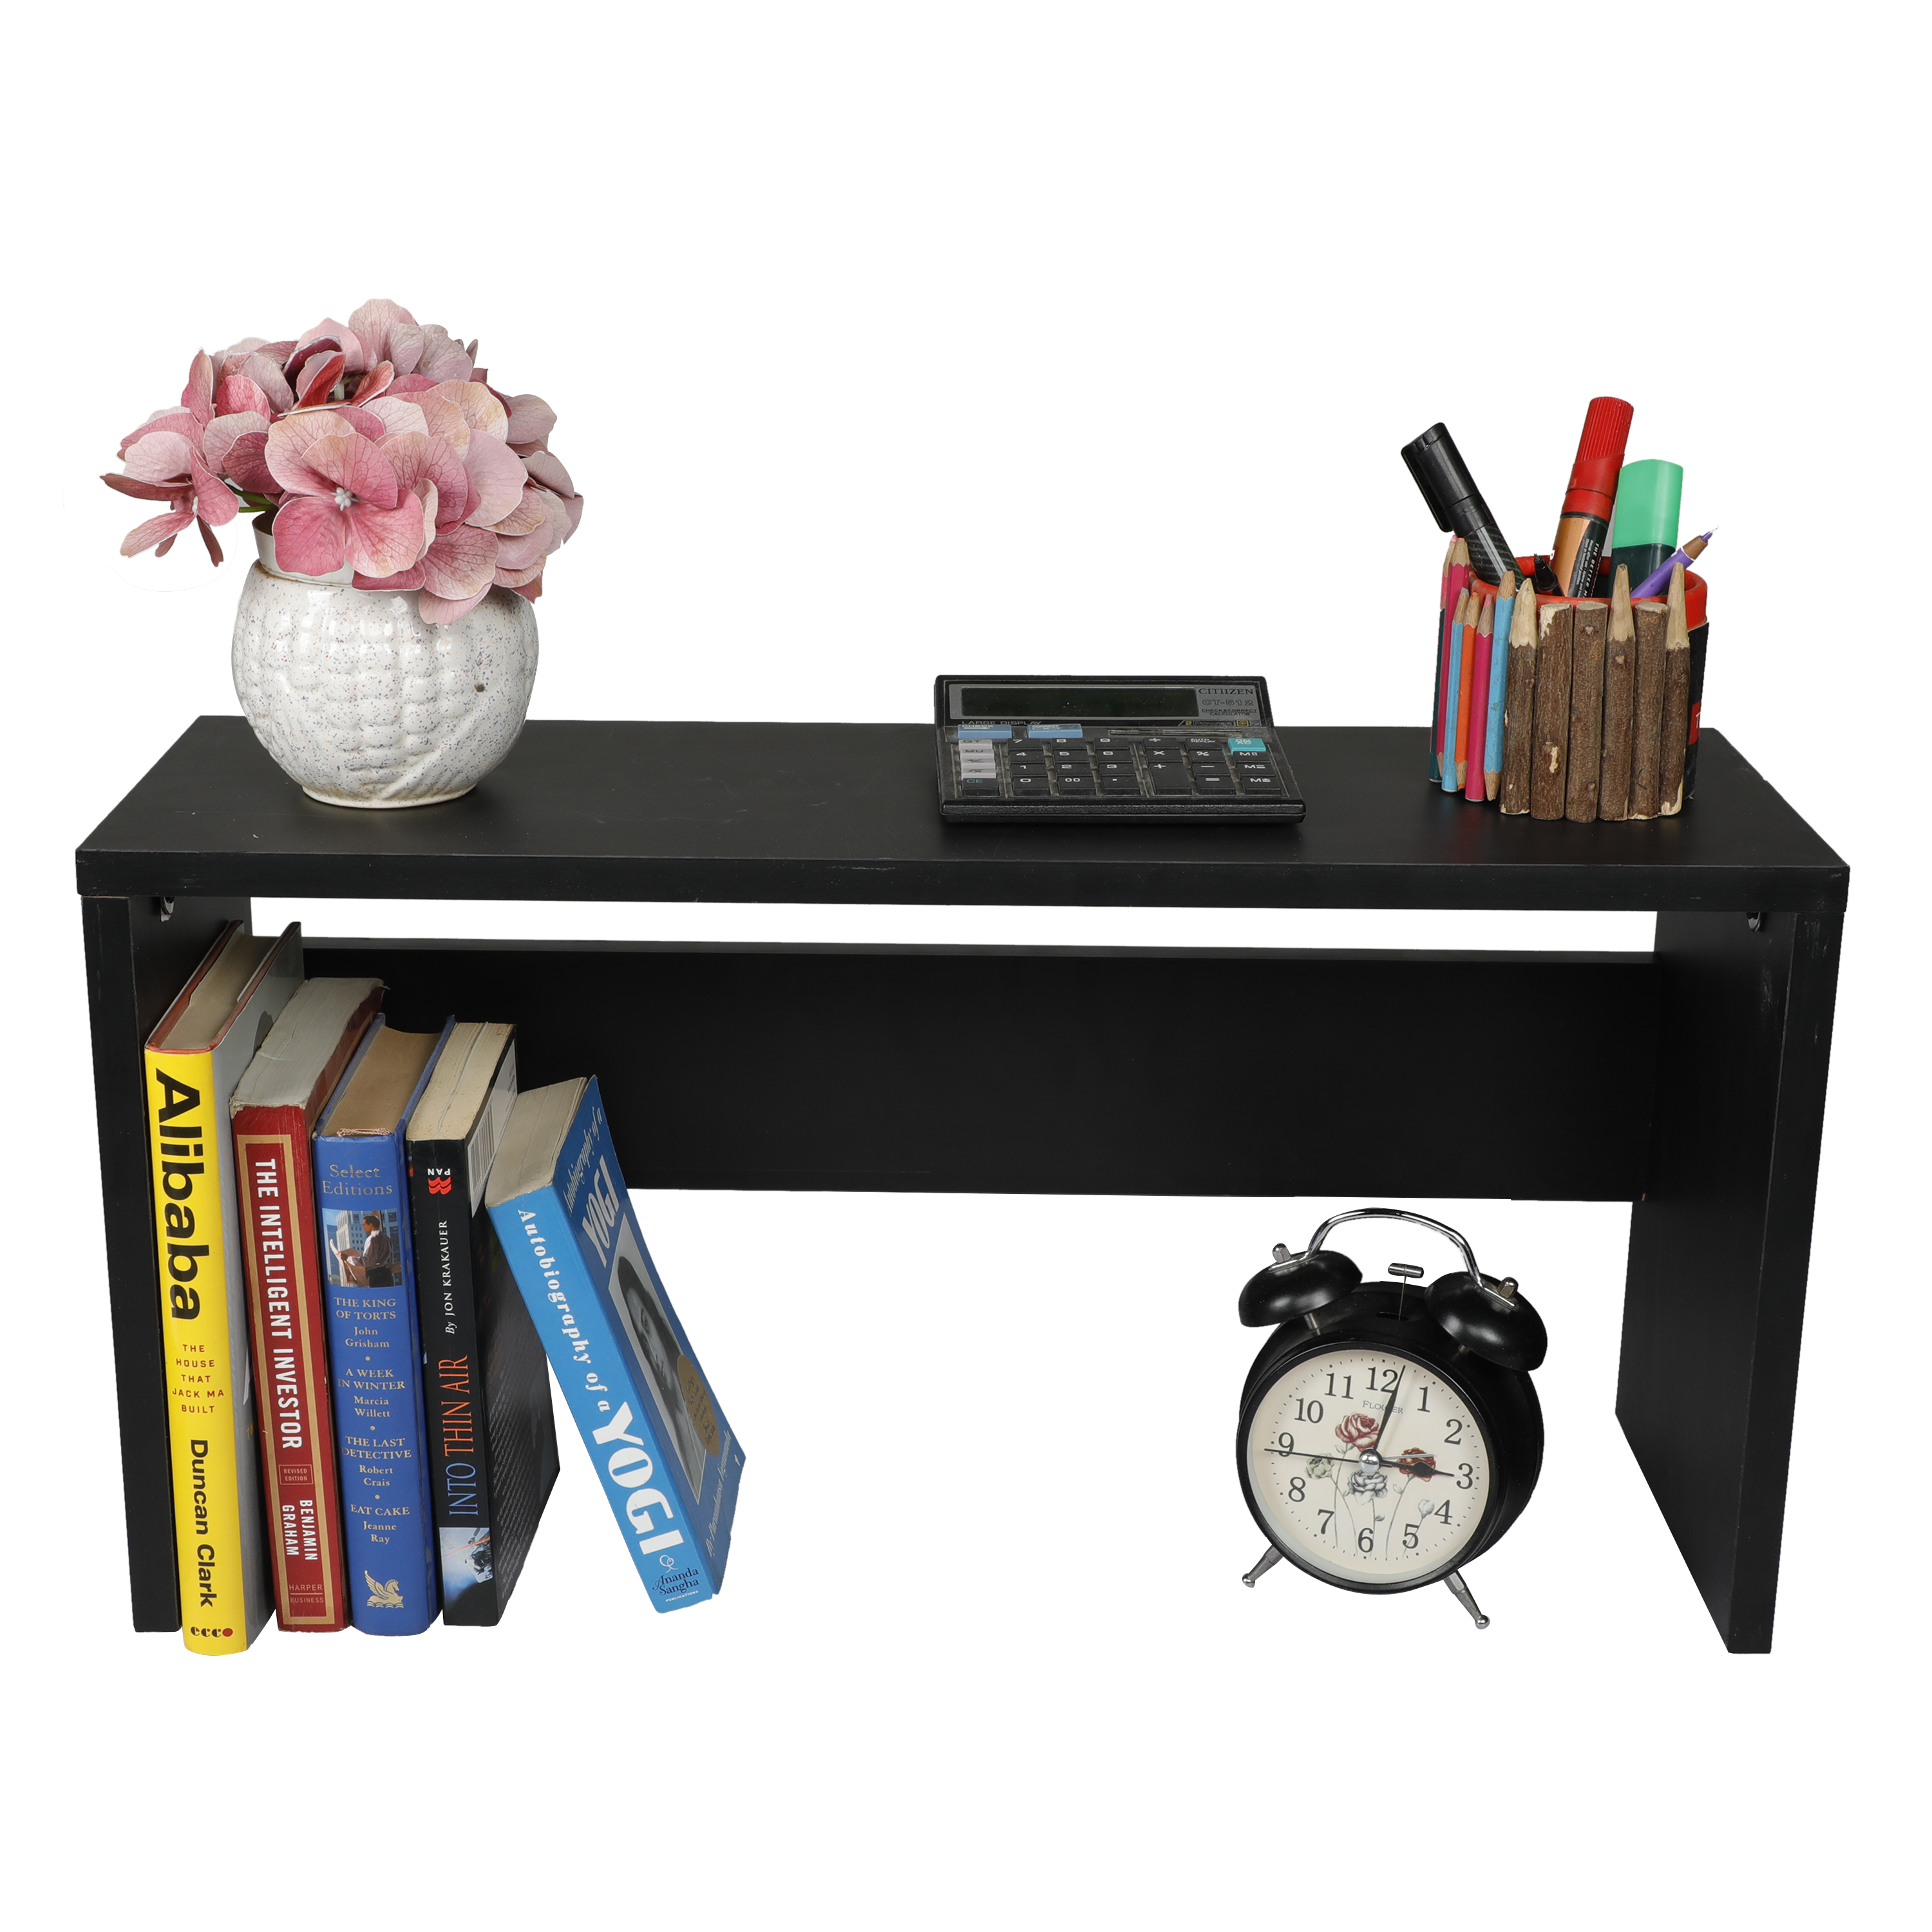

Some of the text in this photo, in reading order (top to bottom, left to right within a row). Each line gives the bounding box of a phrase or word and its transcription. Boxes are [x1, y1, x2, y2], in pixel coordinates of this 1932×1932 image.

[329, 1164, 381, 1179] Select
[156, 1068, 209, 1320] Alibaba
[322, 1180, 393, 1197] Editions
[582, 1155, 620, 1268] YOGI
[439, 1220, 457, 1334] By JON KRAKAUER
[255, 1158, 303, 1449] THE INTELLIGENT INVESTOR
[334, 1297, 397, 1308] THE KING
[518, 1209, 611, 1412] Autobiography of a
[336, 1310, 396, 1320] OF TORTS
[354, 1327, 378, 1336] John
[182, 1344, 205, 1352] THE
[345, 1338, 390, 1348] Grisham
[176, 1358, 214, 1368] HOUSE
[181, 1374, 211, 1383] THAT
[357, 1368, 395, 1378] WEEK
[1365, 1366, 1399, 1394] 12
[337, 1378, 406, 1390] IN WINTER
[1324, 1372, 1354, 1399] 11
[172, 1388, 224, 1398] JACK MA
[354, 1395, 389, 1405] Marcia
[1417, 1386, 1431, 1413] 1
[181, 1405, 214, 1413] BUILT
[354, 1408, 391, 1417] Willett
[1294, 1397, 1324, 1424] 10
[438, 1355, 478, 1515] INTO THIN AIR
[1444, 1419, 1463, 1445] 2
[345, 1435, 406, 1448] THE LAST
[1278, 1432, 1294, 1457] 9
[342, 1447, 412, 1460] DETECTIVE
[359, 1464, 393, 1475] Robert
[592, 1401, 684, 1555] YOGI
[1455, 1463, 1474, 1490] 3
[363, 1477, 391, 1487] Crais
[1288, 1476, 1307, 1502] 8
[350, 1504, 410, 1516] EAT CAKE
[1434, 1499, 1454, 1525] 4
[191, 1439, 217, 1607] Duncan Clark
[282, 1504, 299, 1555] GRAHAM
[299, 1499, 318, 1561] BENJAMIN
[363, 1520, 397, 1531] Jeanne
[1317, 1509, 1335, 1535] 7
[370, 1533, 390, 1545] Ray
[1358, 1528, 1374, 1553] 6
[1403, 1523, 1419, 1549] 5
[652, 1567, 699, 1591] Ananda
[659, 1579, 700, 1596] Sangha
[665, 1590, 699, 1602] PUBLICATIONS
